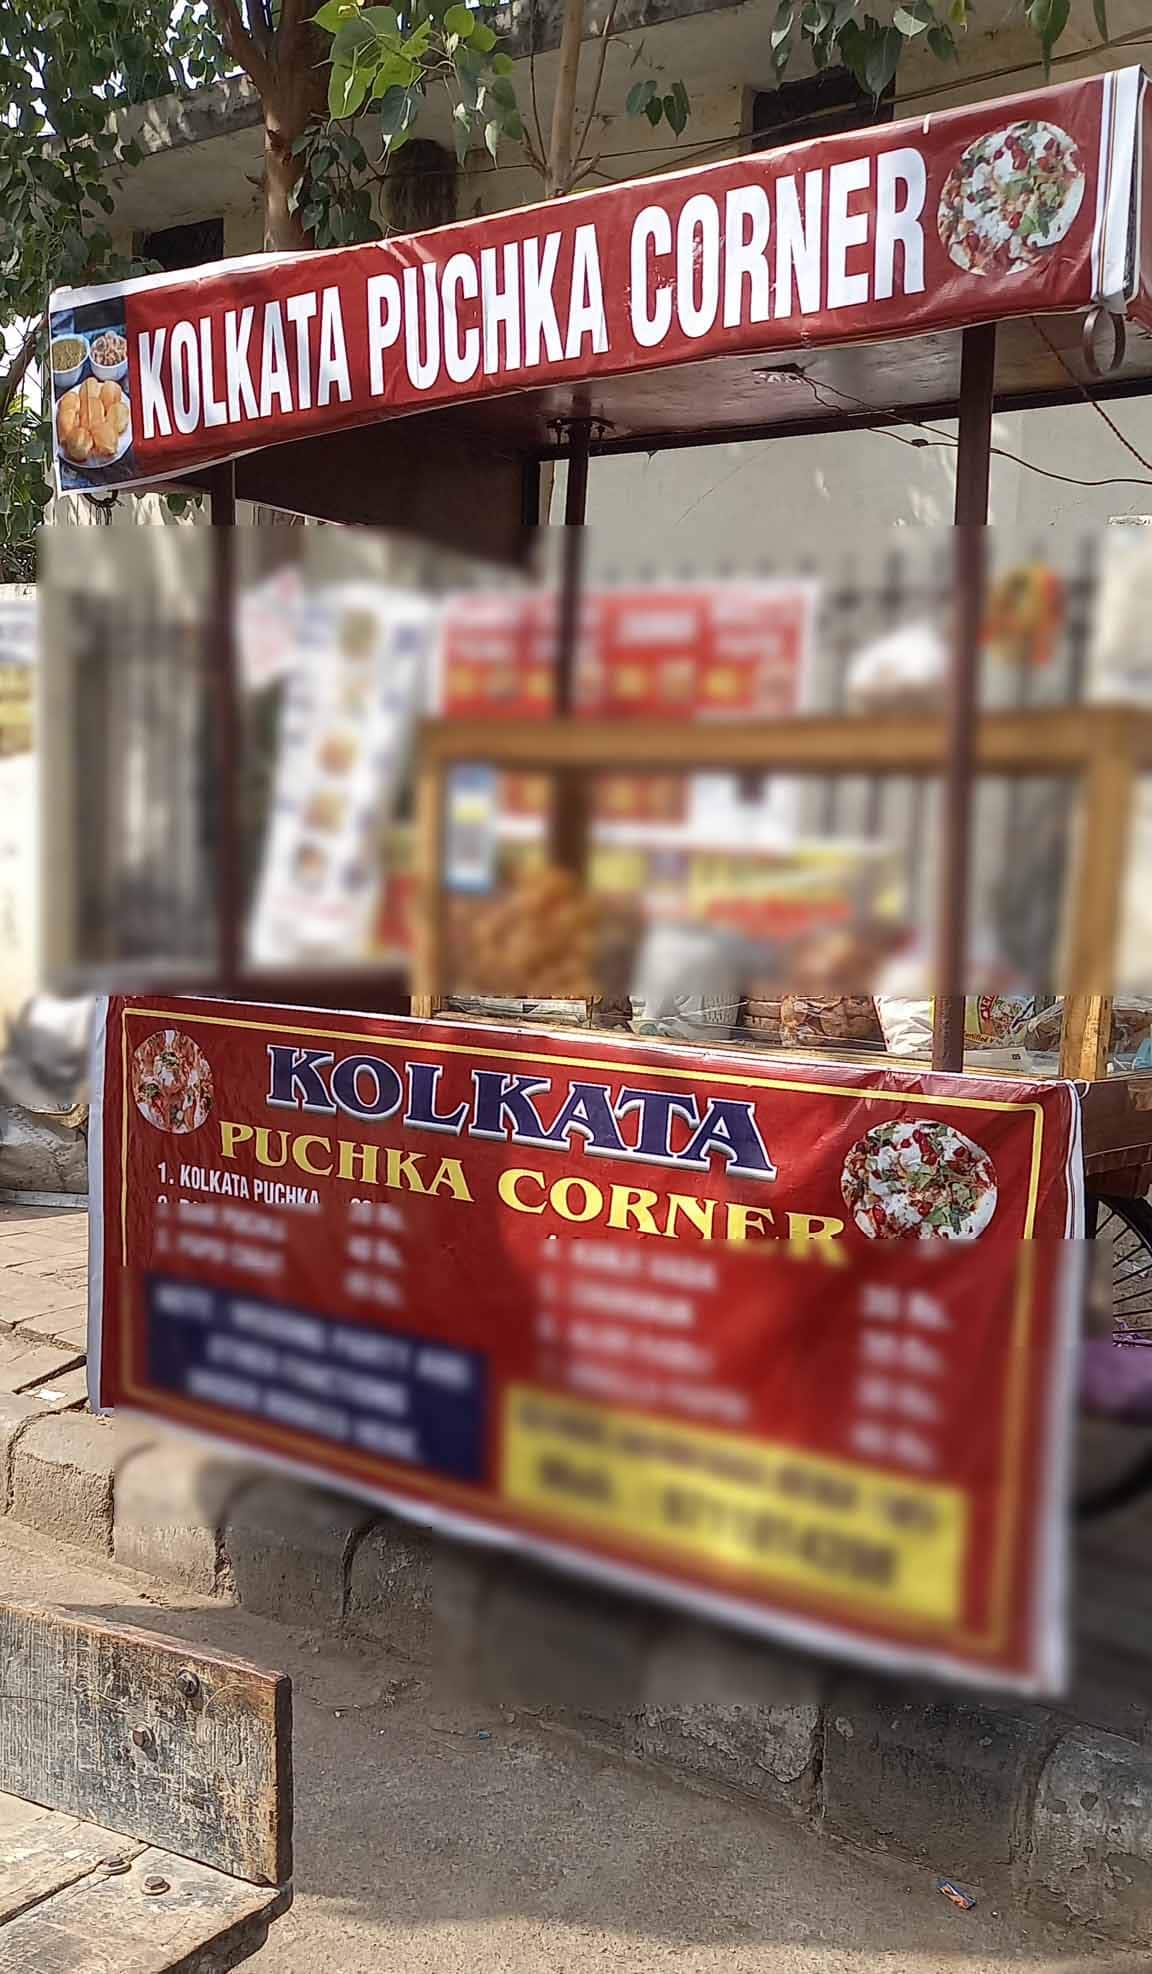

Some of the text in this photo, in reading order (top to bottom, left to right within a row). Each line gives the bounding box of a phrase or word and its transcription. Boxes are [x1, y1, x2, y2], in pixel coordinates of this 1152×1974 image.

[137, 147, 927, 439] KOLKATA PUCHKA CORNER
[265, 1044, 779, 1182] KOLKATA
[157, 1161, 321, 1210] 1. KOLKATA PUCHKA
[218, 1120, 475, 1203] PUCHKA
[497, 1168, 846, 1265] CORNER
